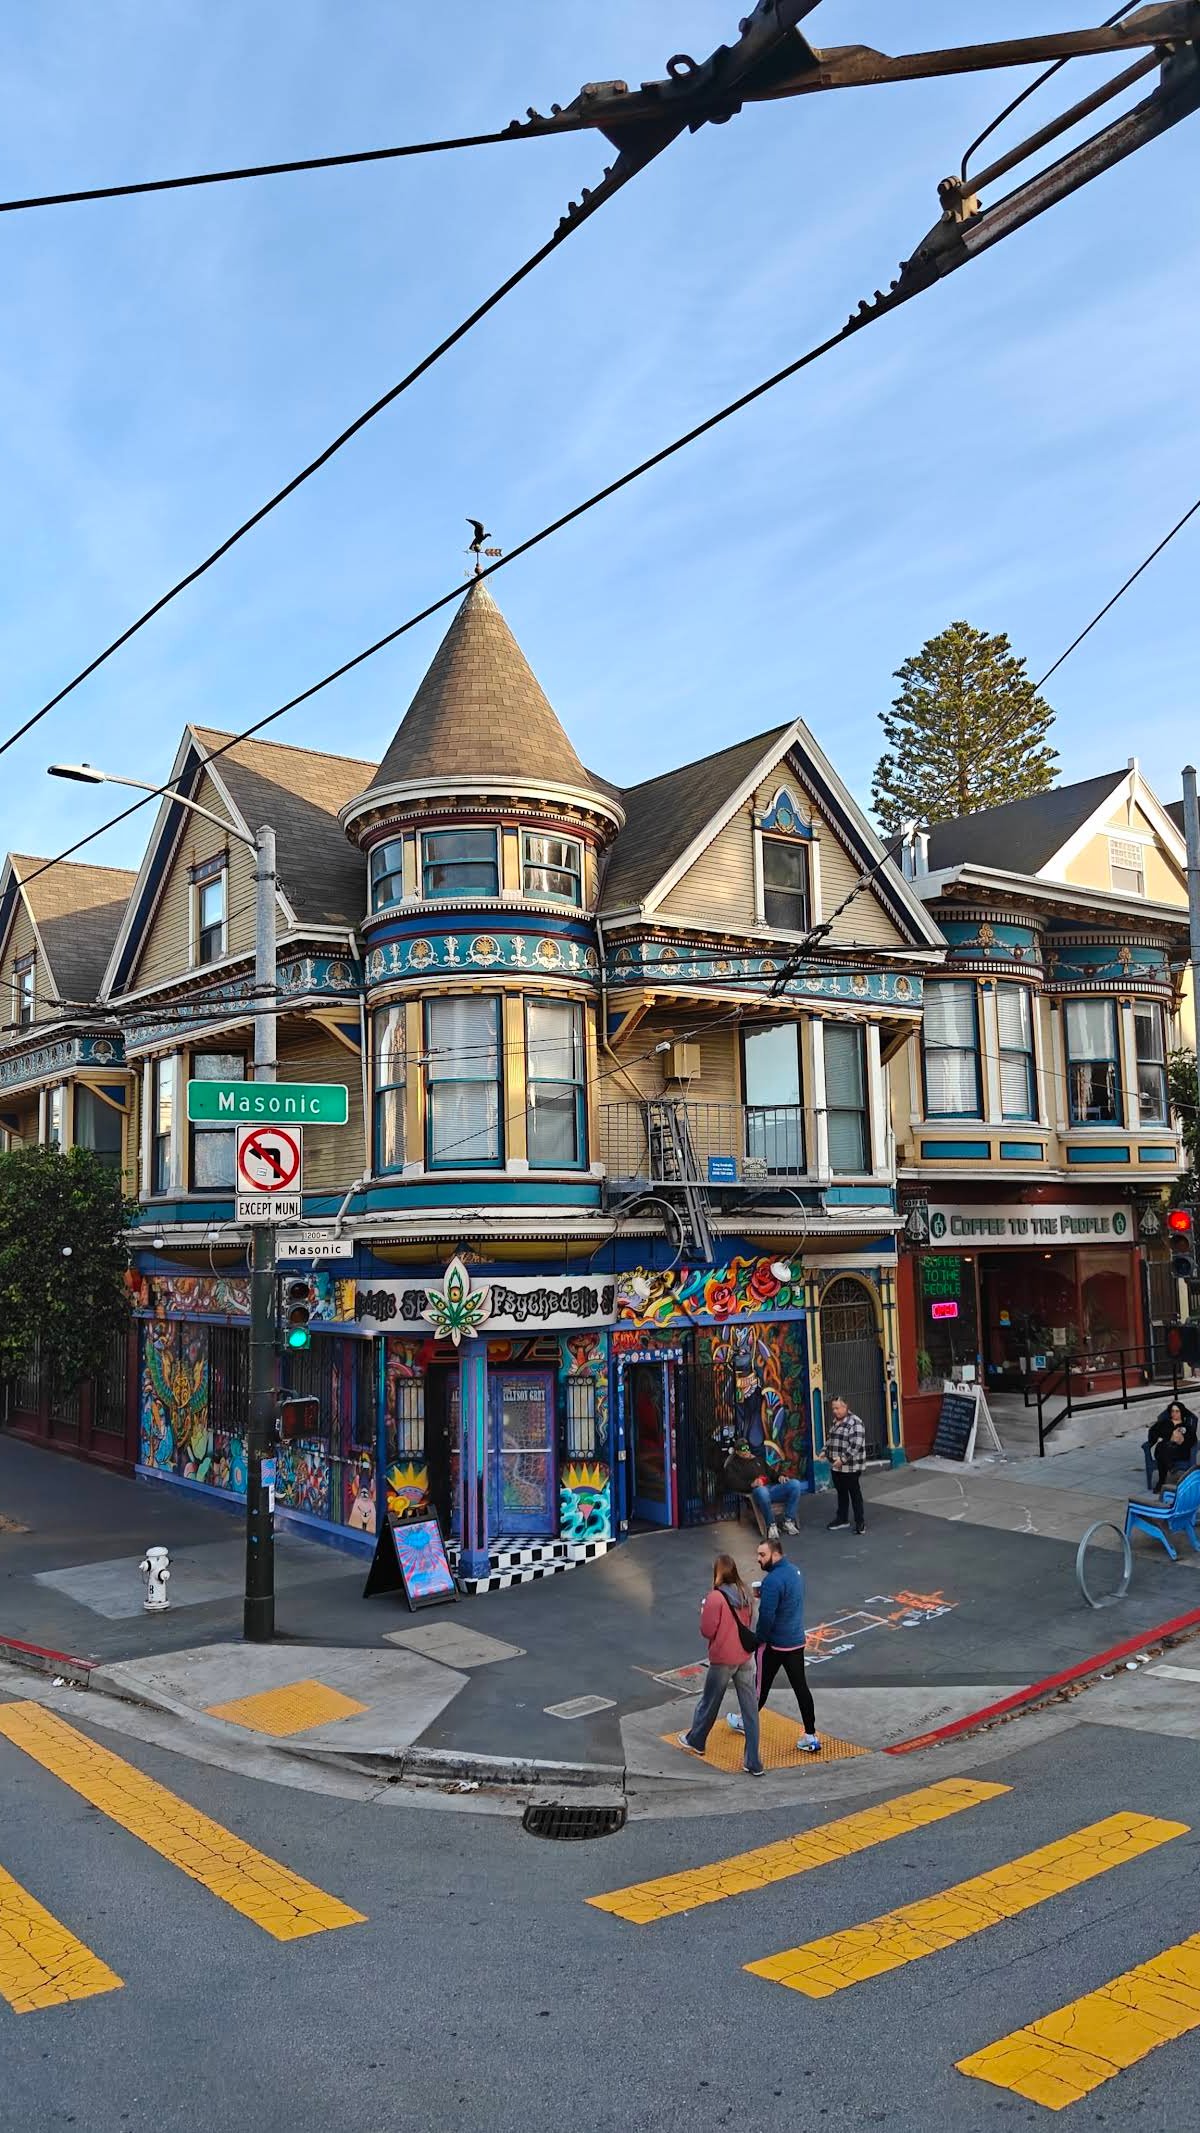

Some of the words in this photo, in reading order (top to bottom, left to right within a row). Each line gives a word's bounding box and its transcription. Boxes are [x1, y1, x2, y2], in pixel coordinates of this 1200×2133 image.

[218, 1091, 321, 1114] Masonic
[239, 1202, 272, 1216] EXCEPT
[275, 1202, 299, 1216] MUNI
[950, 1215, 1006, 1236] COFFEE
[1008, 1218, 1029, 1236] TO
[1030, 1217, 1058, 1235] THE
[1060, 1214, 1110, 1235] PEOPLE
[288, 1244, 342, 1255] Masonic
[925, 1270, 939, 1282] TO
[942, 1269, 961, 1281] THE
[489, 1284, 599, 1322] Psychedelic
